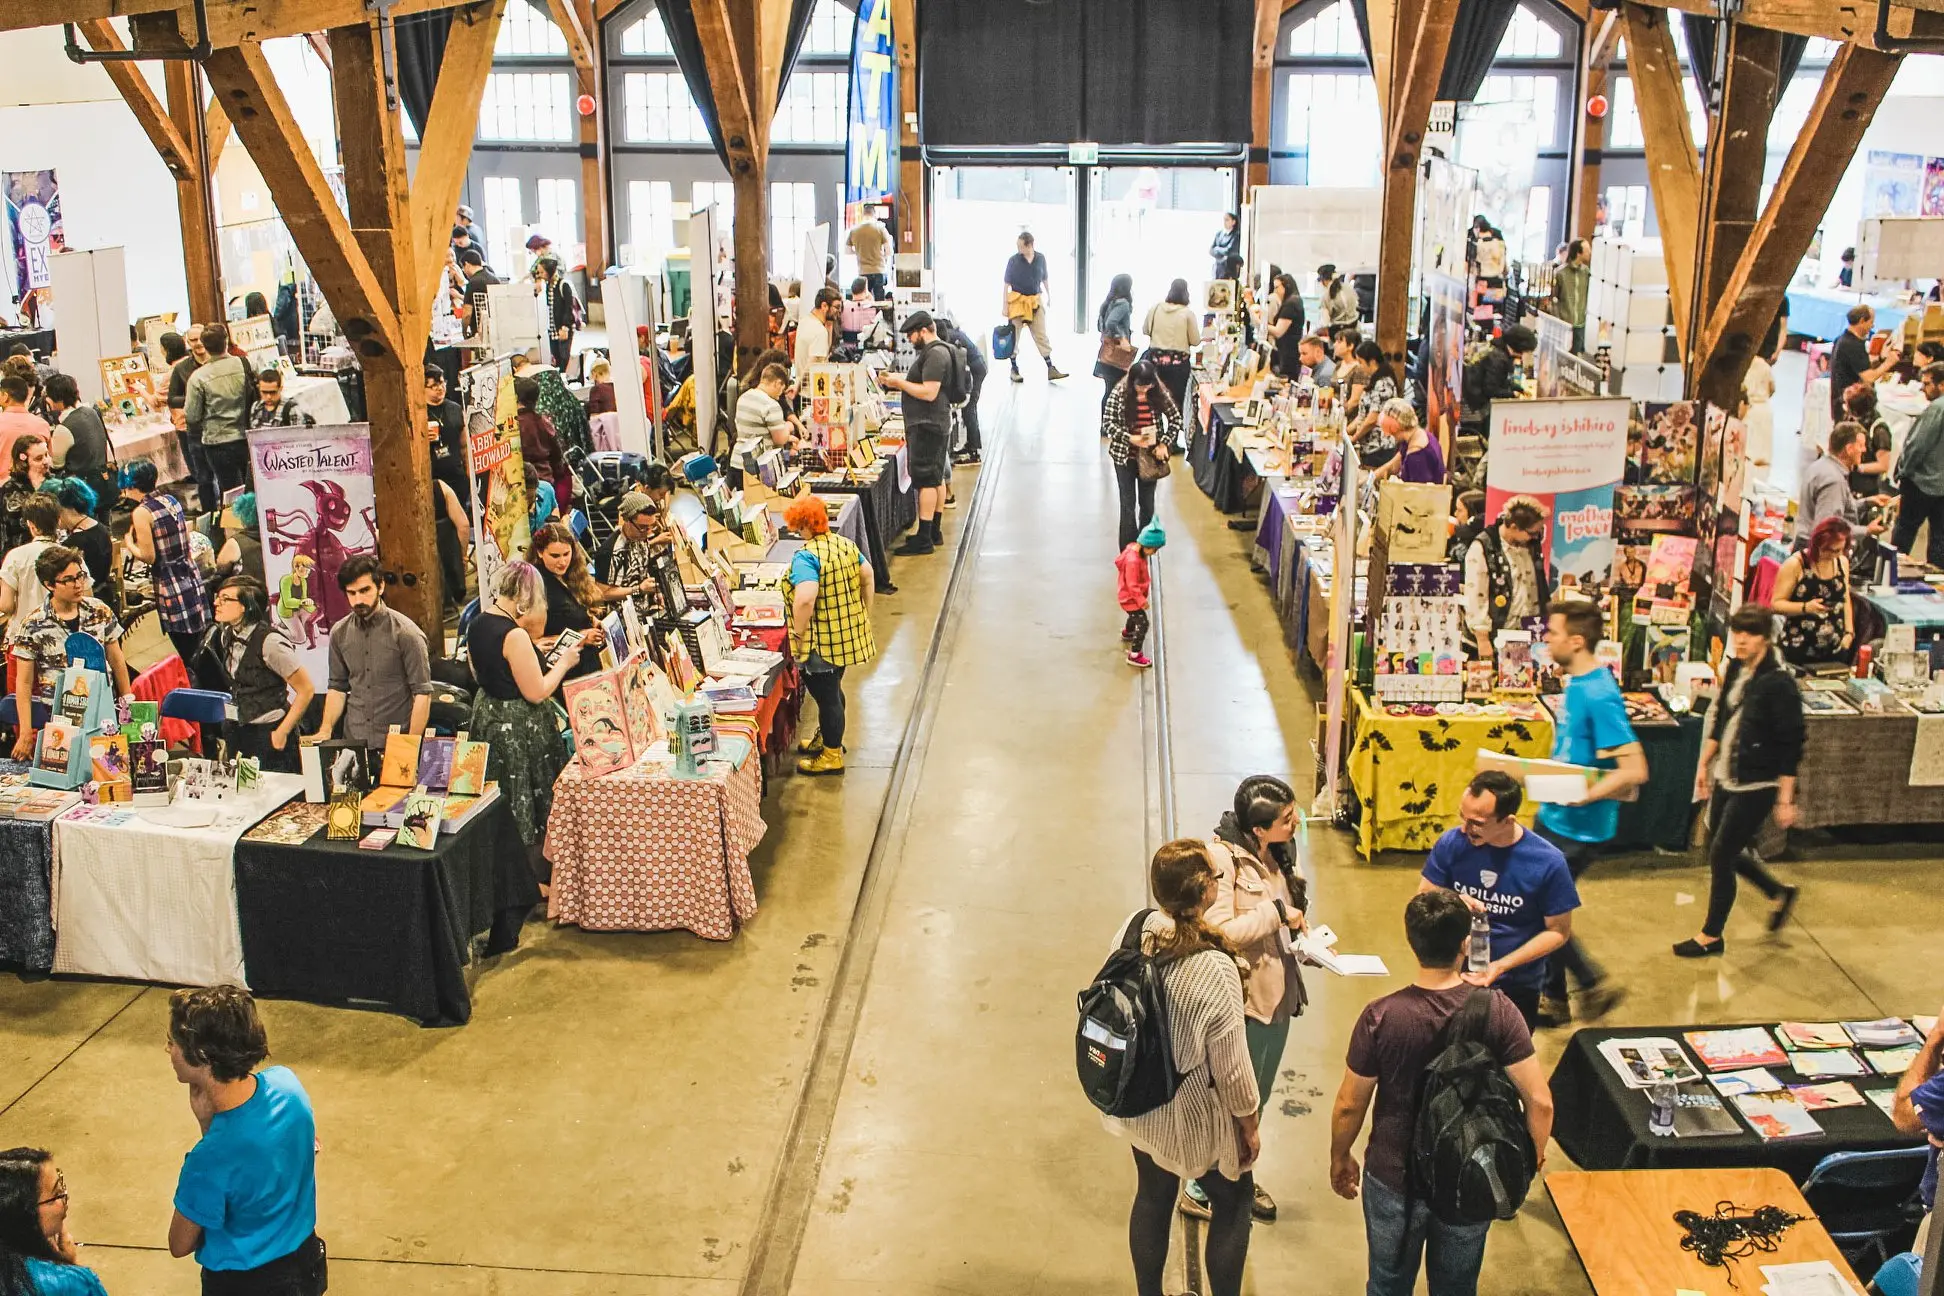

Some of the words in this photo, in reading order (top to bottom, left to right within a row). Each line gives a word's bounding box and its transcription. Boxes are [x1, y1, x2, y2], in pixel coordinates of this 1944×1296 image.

[851, 0, 892, 192] ATM
[1502, 418, 1557, 438] lindsay
[470, 431, 495, 453] ABBY
[263, 449, 314, 473] WASTED
[474, 442, 511, 472] HOWARD
[1454, 881, 1524, 907] CAPILANO
[1486, 903, 1517, 915] RSITY
